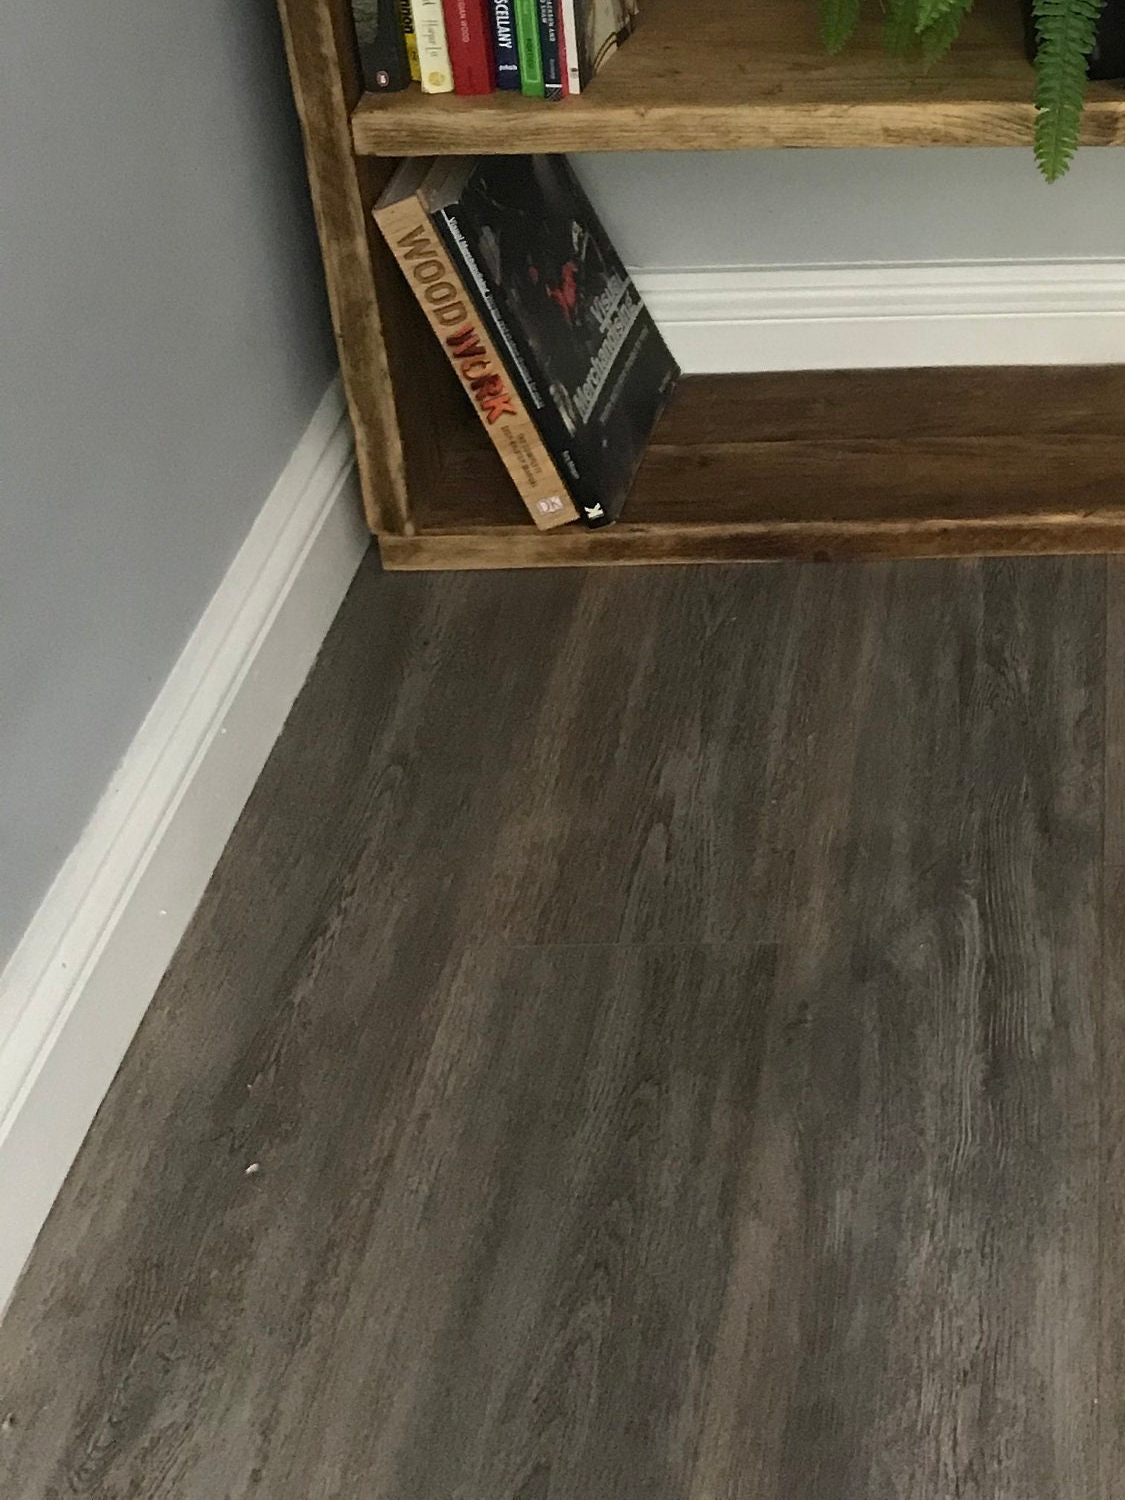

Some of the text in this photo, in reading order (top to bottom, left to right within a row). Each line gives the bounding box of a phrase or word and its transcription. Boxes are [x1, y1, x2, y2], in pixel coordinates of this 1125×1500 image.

[539, 3, 548, 24] SHAW
[457, 19, 471, 43] WOOD
[547, 27, 556, 42] AND
[446, 216, 465, 242] Visual
[590, 269, 631, 330] Visual
